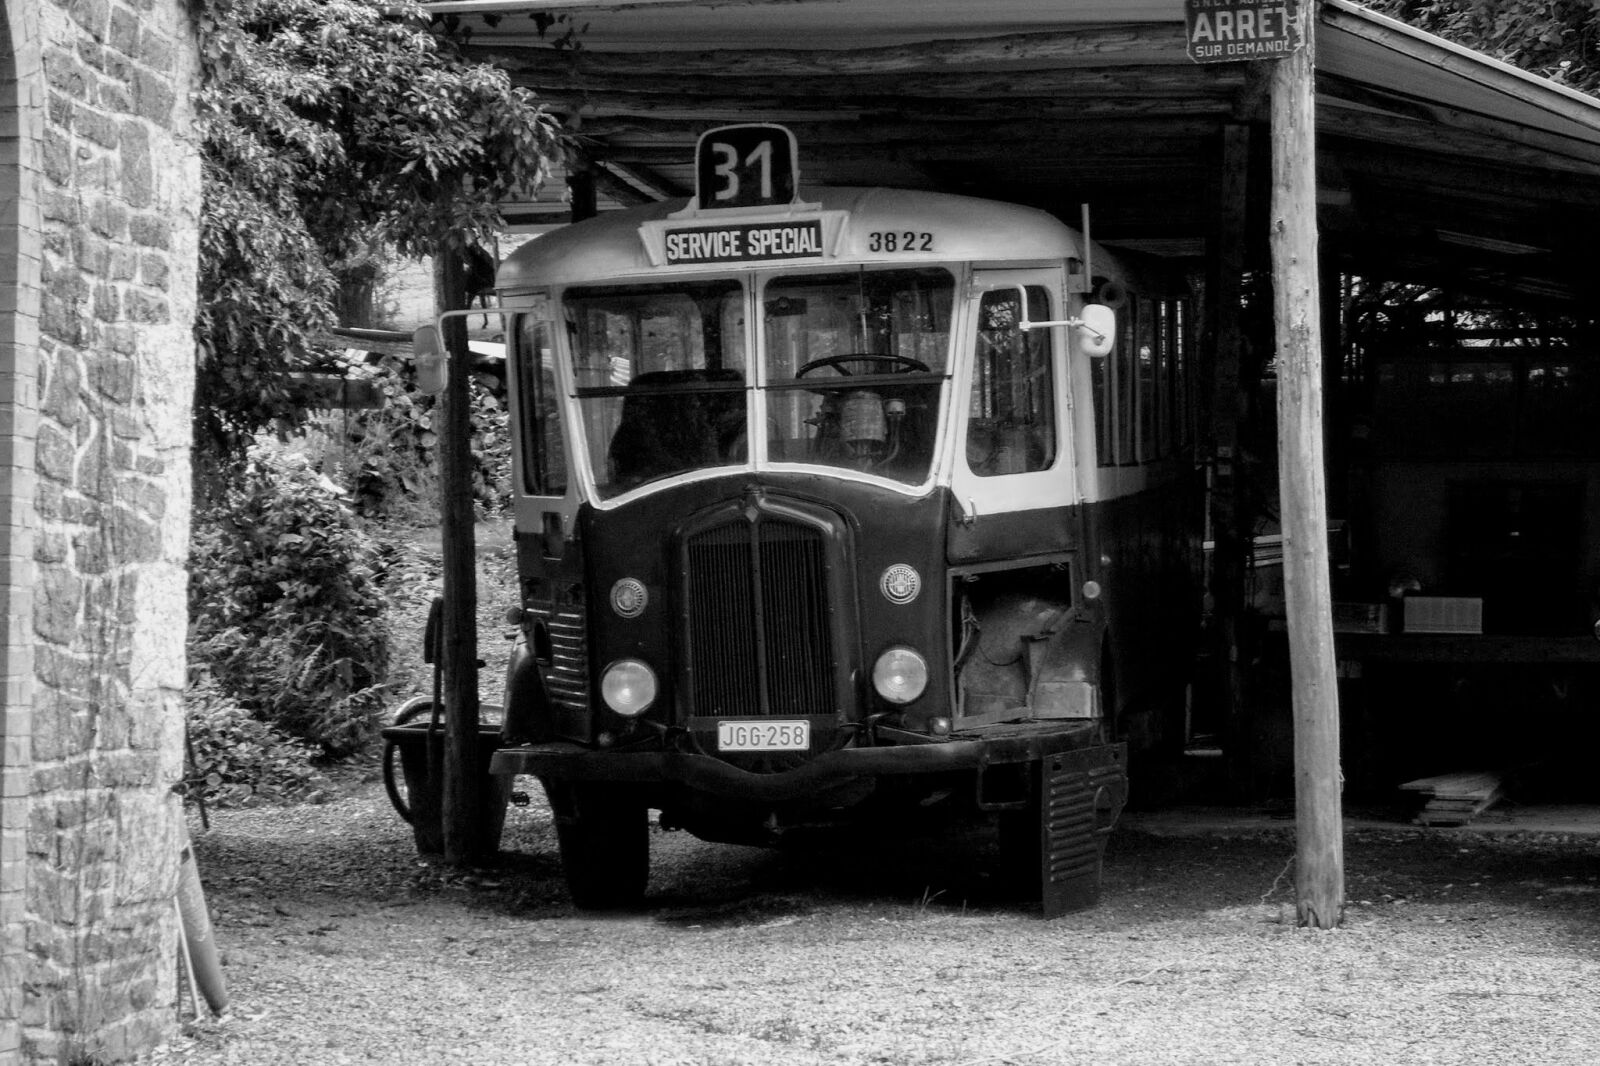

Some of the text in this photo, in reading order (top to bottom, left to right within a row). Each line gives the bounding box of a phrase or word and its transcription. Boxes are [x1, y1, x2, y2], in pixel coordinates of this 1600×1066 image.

[1195, 45, 1223, 58] SUR
[711, 140, 774, 200] 31
[666, 226, 821, 260] SERVICE SPECIAL
[869, 231, 933, 252] 3822
[722, 725, 804, 747] JGG-258
